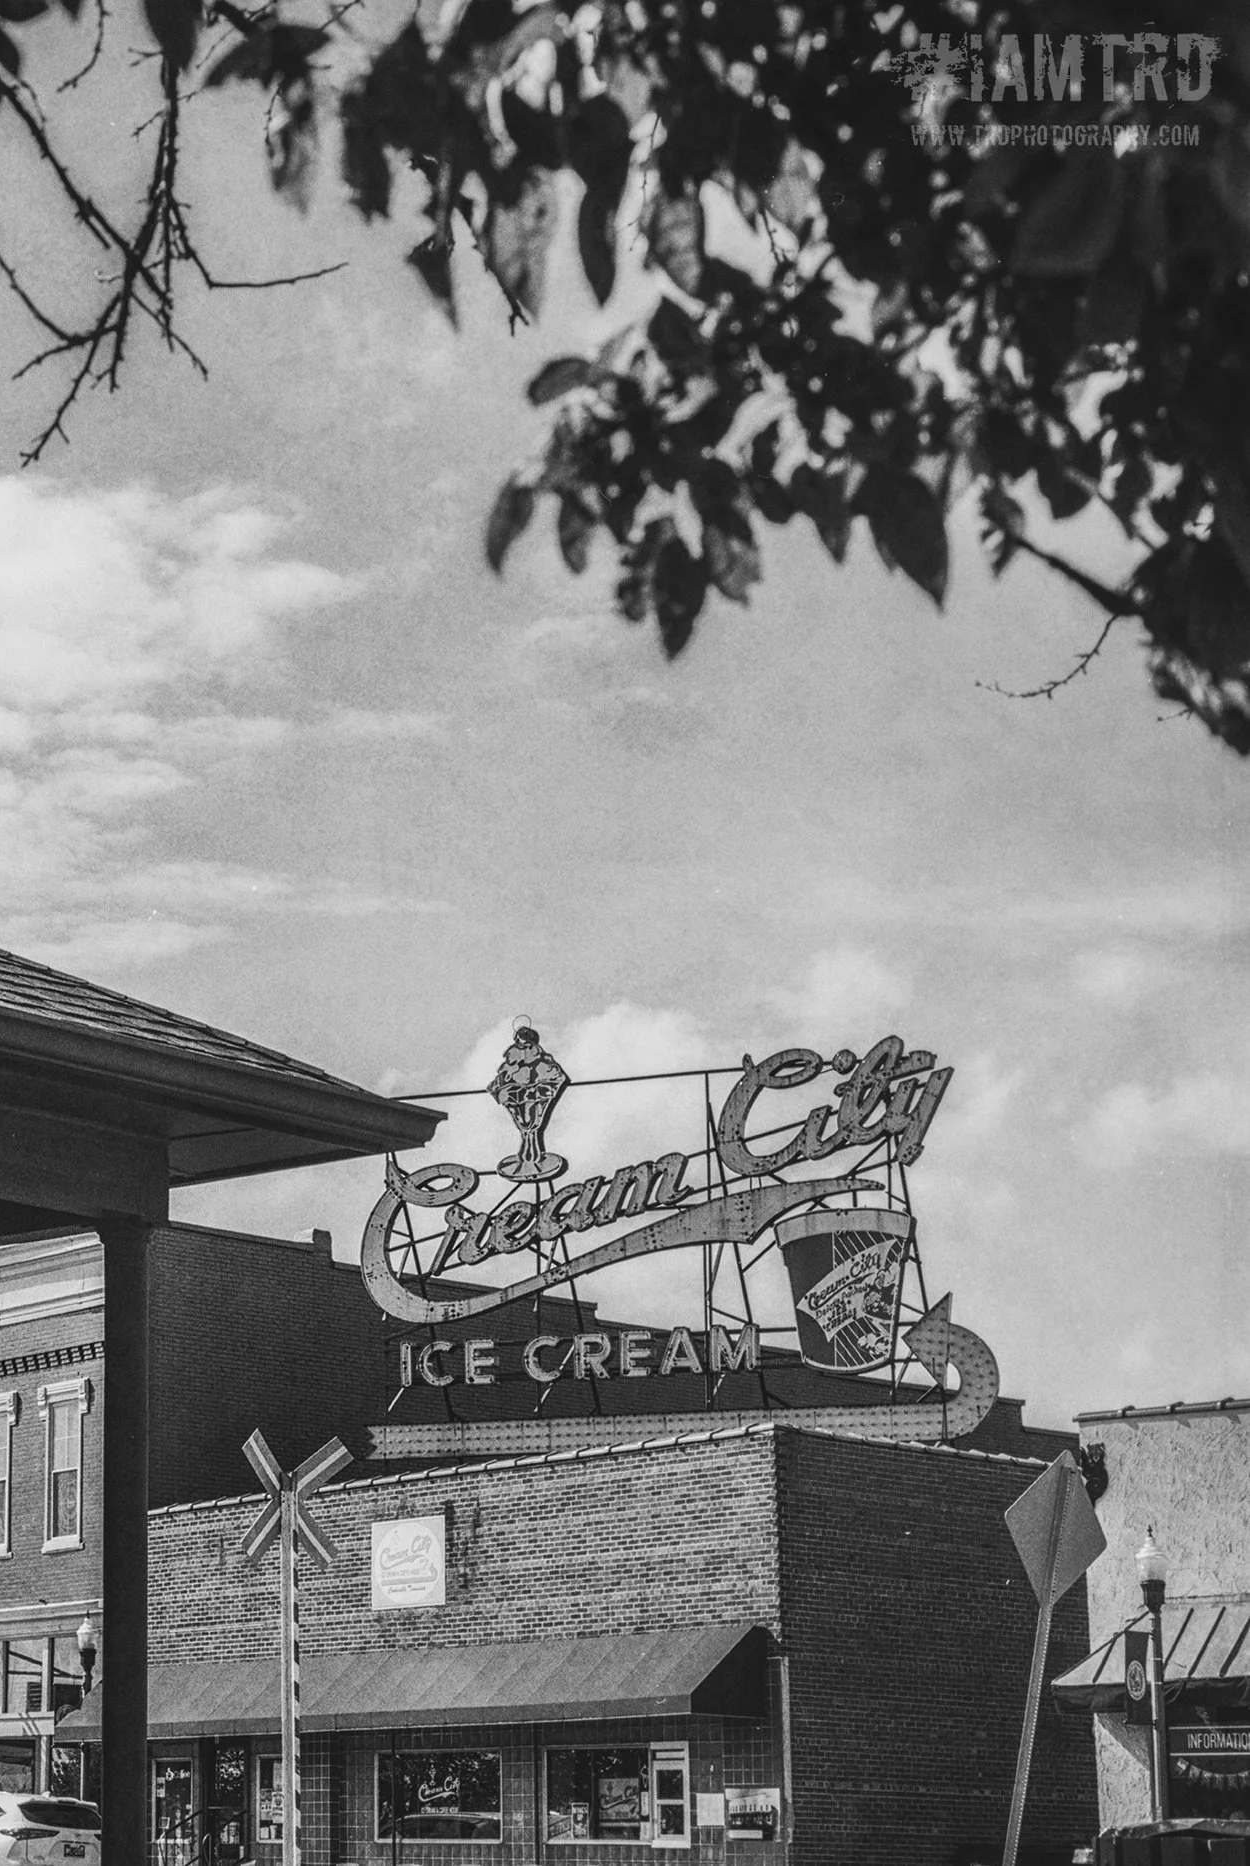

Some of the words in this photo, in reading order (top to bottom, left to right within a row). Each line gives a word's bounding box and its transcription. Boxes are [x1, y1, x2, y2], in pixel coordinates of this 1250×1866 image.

[360, 1151, 694, 1323] Cream
[717, 1034, 954, 1178] City
[399, 1338, 496, 1388] ICE
[523, 1322, 761, 1383] CREAM
[1187, 1732, 1250, 1749] INFORMATIO
